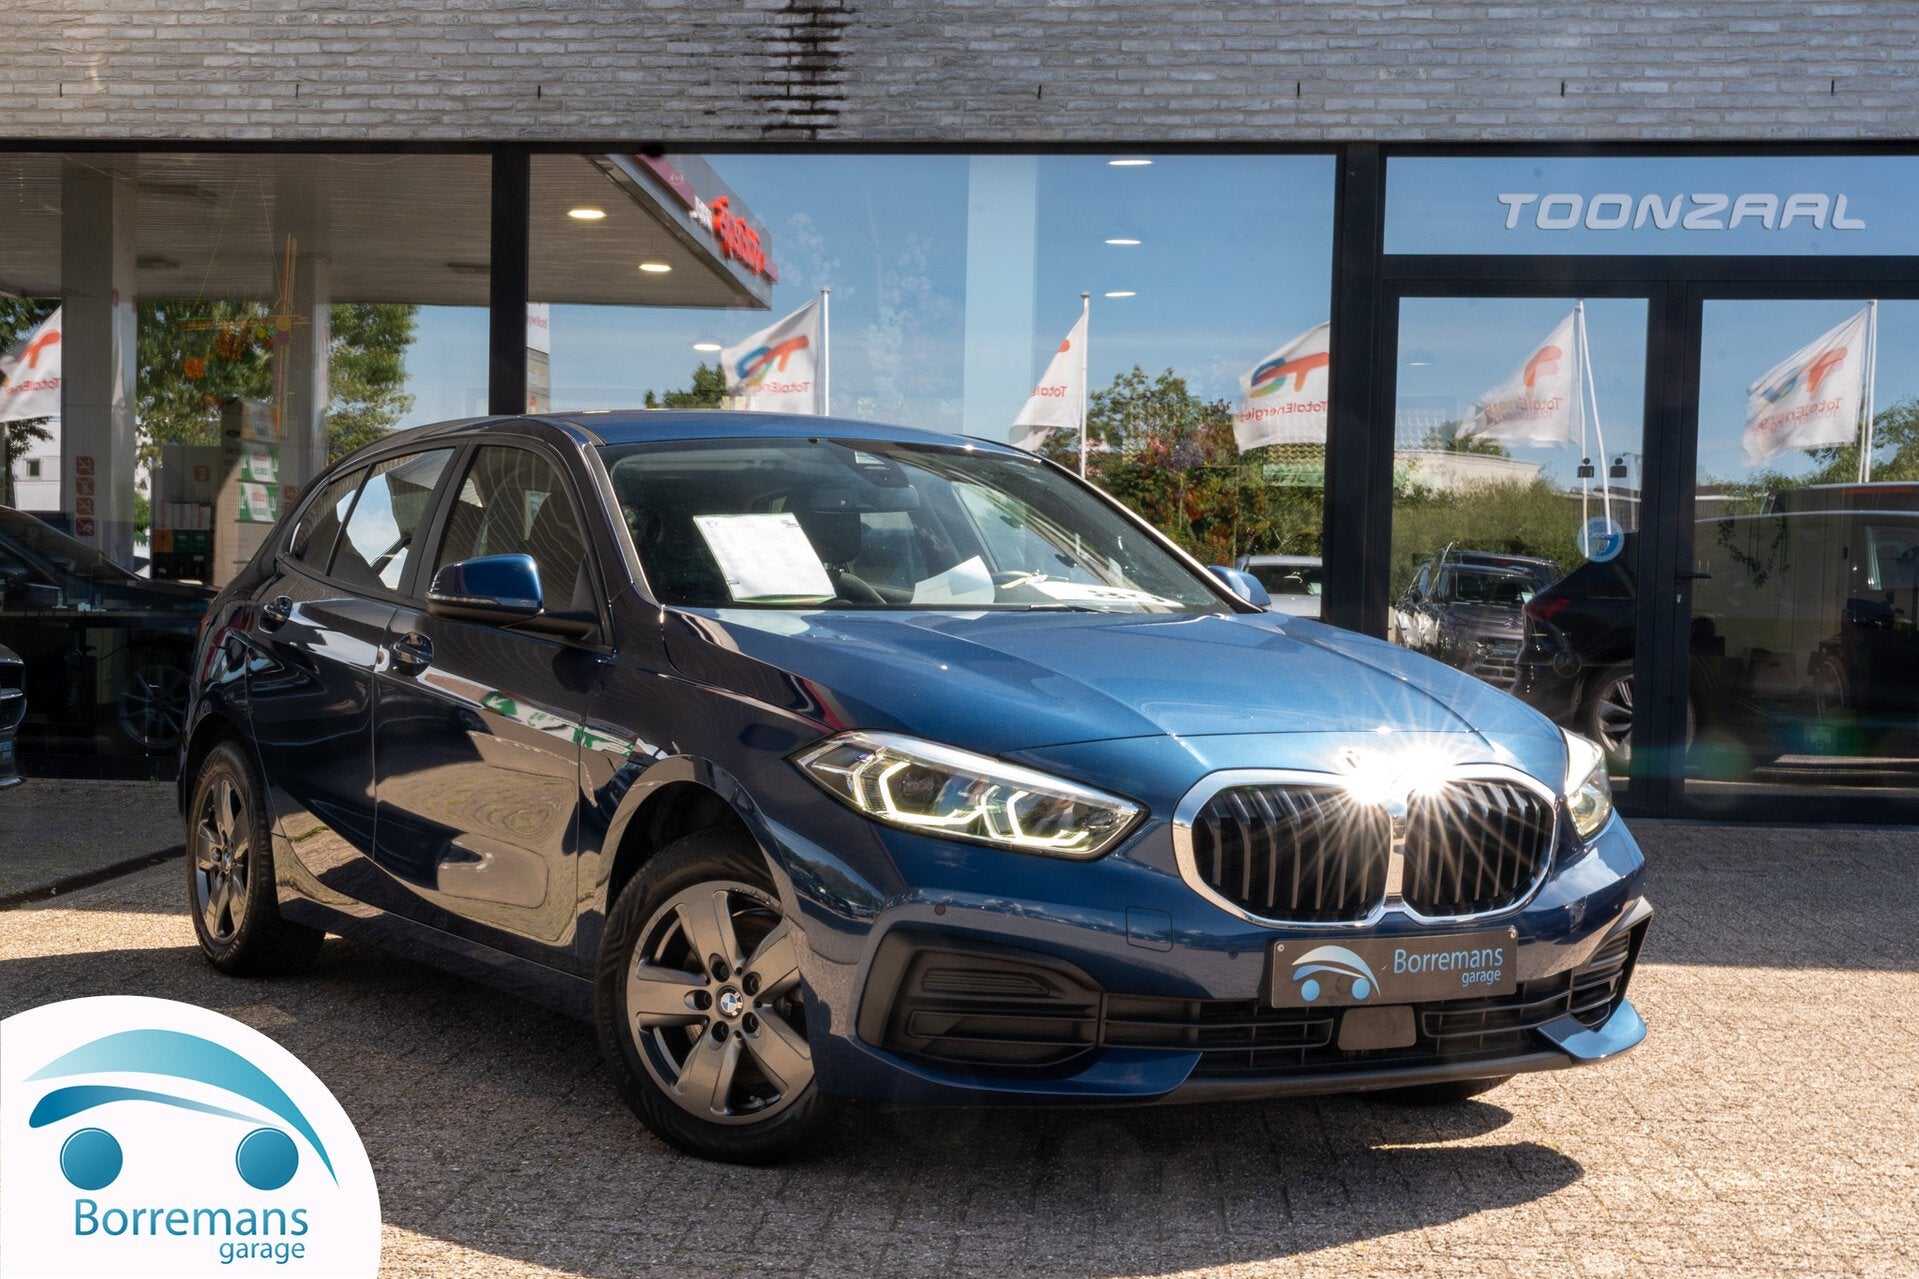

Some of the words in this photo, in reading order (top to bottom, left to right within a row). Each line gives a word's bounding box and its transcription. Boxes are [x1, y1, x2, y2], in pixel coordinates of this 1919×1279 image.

[1497, 193, 1866, 231] TOONZAAL
[1394, 947, 1503, 974] Borremans
[1462, 969, 1501, 987] garage
